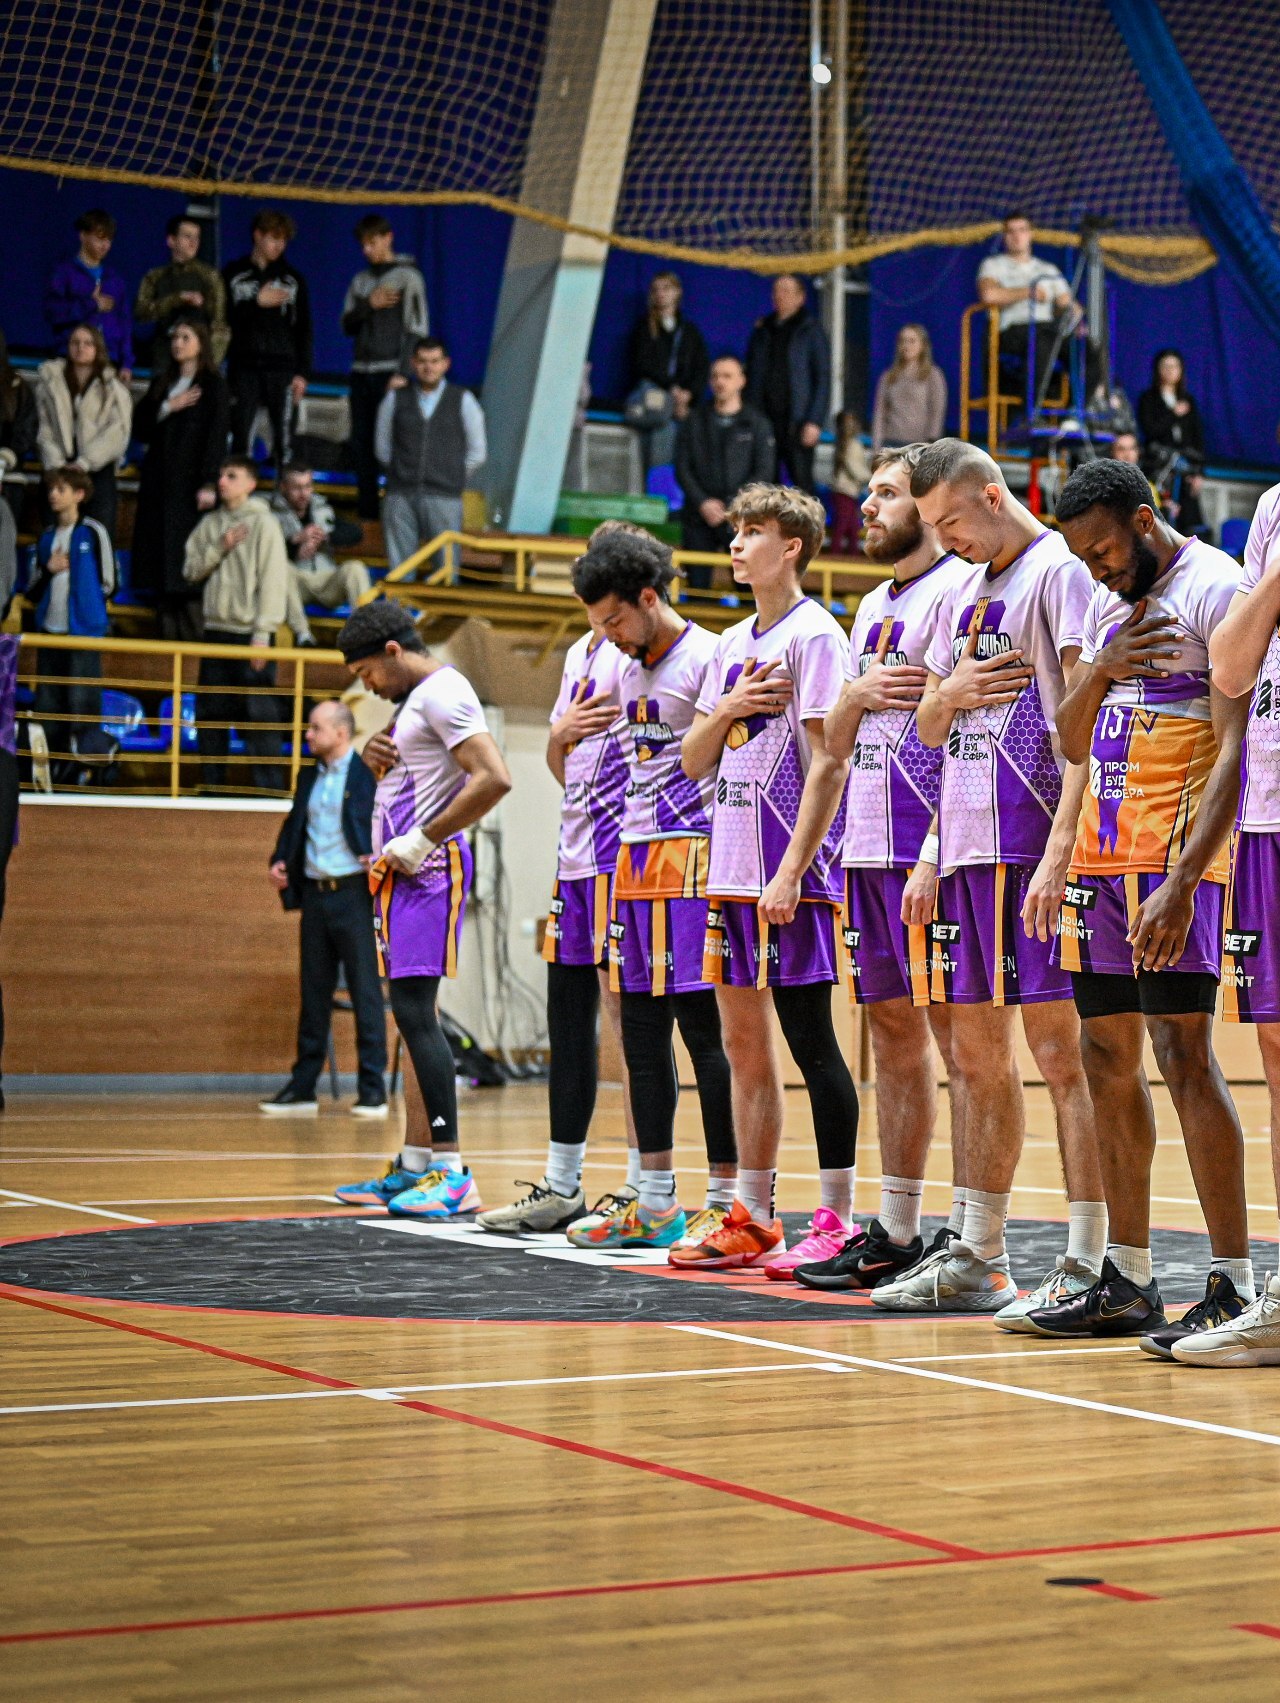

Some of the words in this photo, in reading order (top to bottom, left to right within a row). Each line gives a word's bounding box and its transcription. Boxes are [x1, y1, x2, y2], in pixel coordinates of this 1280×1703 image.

[1104, 761, 1140, 774] ПРОМ
[1105, 774, 1127, 788] БУД
[1103, 787, 1145, 800] СФЕРА
